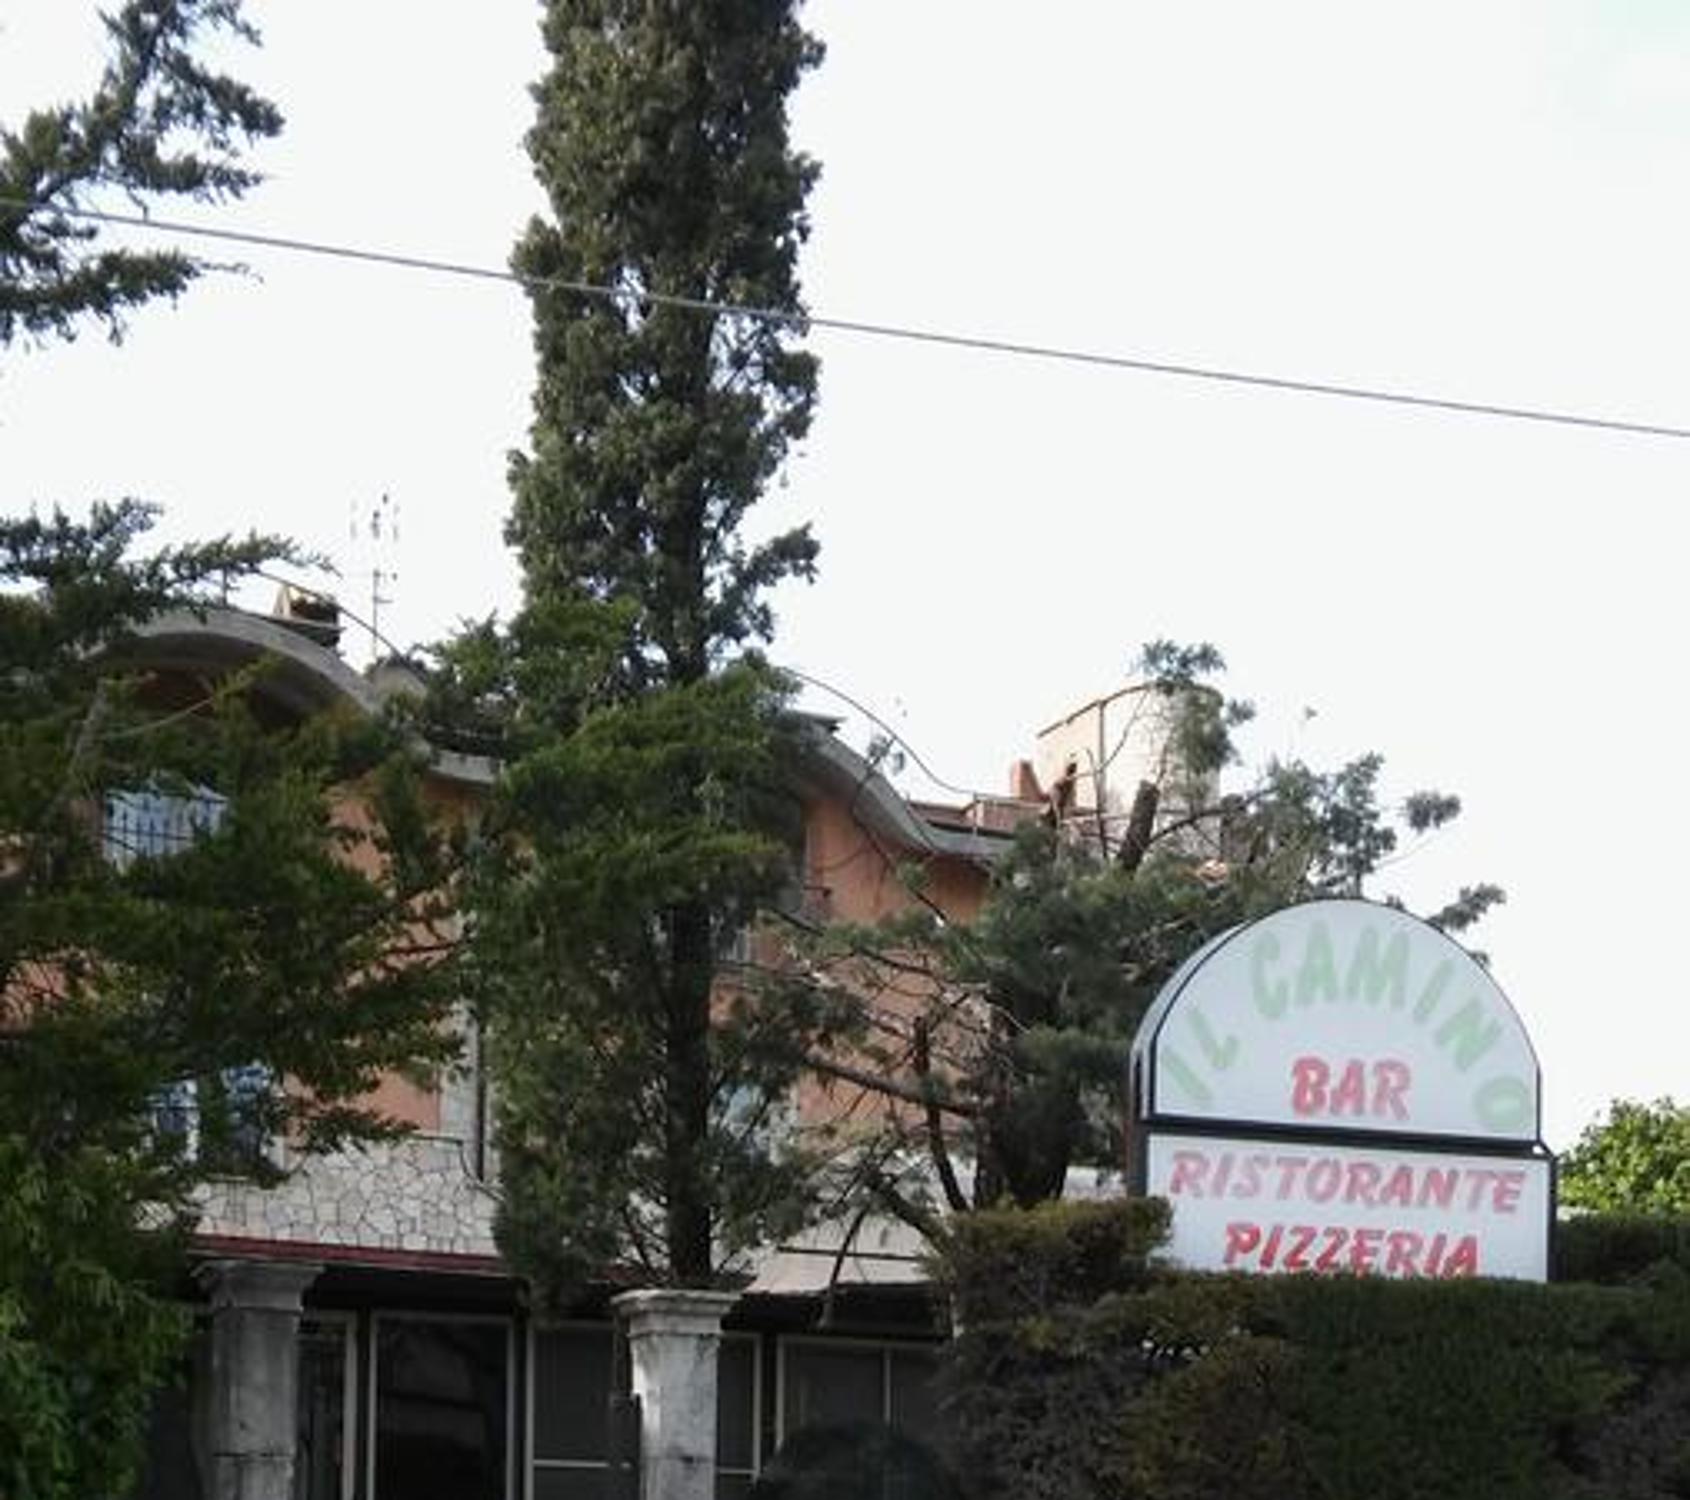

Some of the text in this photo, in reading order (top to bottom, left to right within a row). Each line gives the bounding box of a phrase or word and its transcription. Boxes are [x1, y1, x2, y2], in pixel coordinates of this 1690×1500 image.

[1163, 920, 1533, 1133] IL CAMINO
[1291, 1055, 1411, 1121] BAR
[1169, 1150, 1527, 1213] RISTORANTE
[1223, 1222, 1480, 1278] PIZZERIA
